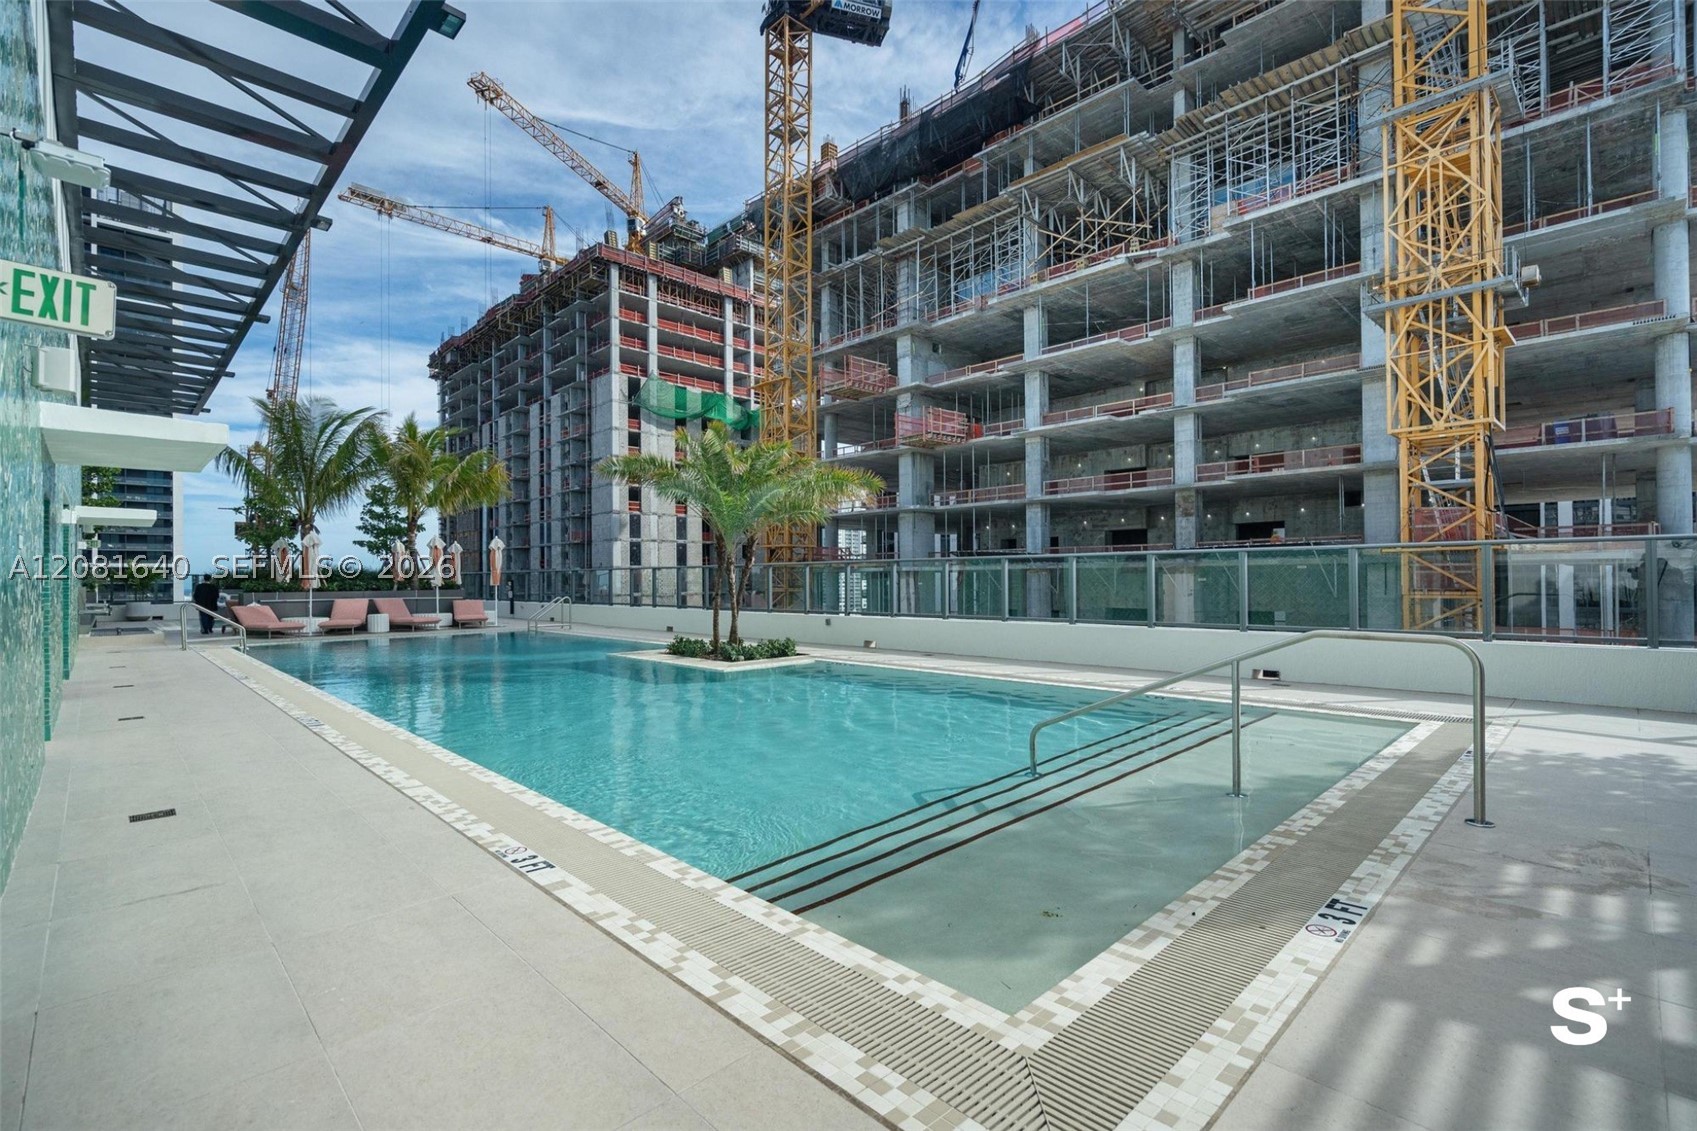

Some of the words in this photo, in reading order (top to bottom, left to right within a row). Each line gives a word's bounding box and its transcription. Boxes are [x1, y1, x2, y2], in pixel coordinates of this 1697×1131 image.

[843, 2, 880, 17] MORROW
[11, 267, 97, 327] EXIT
[510, 854, 539, 863] 3
[518, 860, 556, 873] FT
[1324, 898, 1368, 917] FT
[1317, 913, 1356, 925] 3
